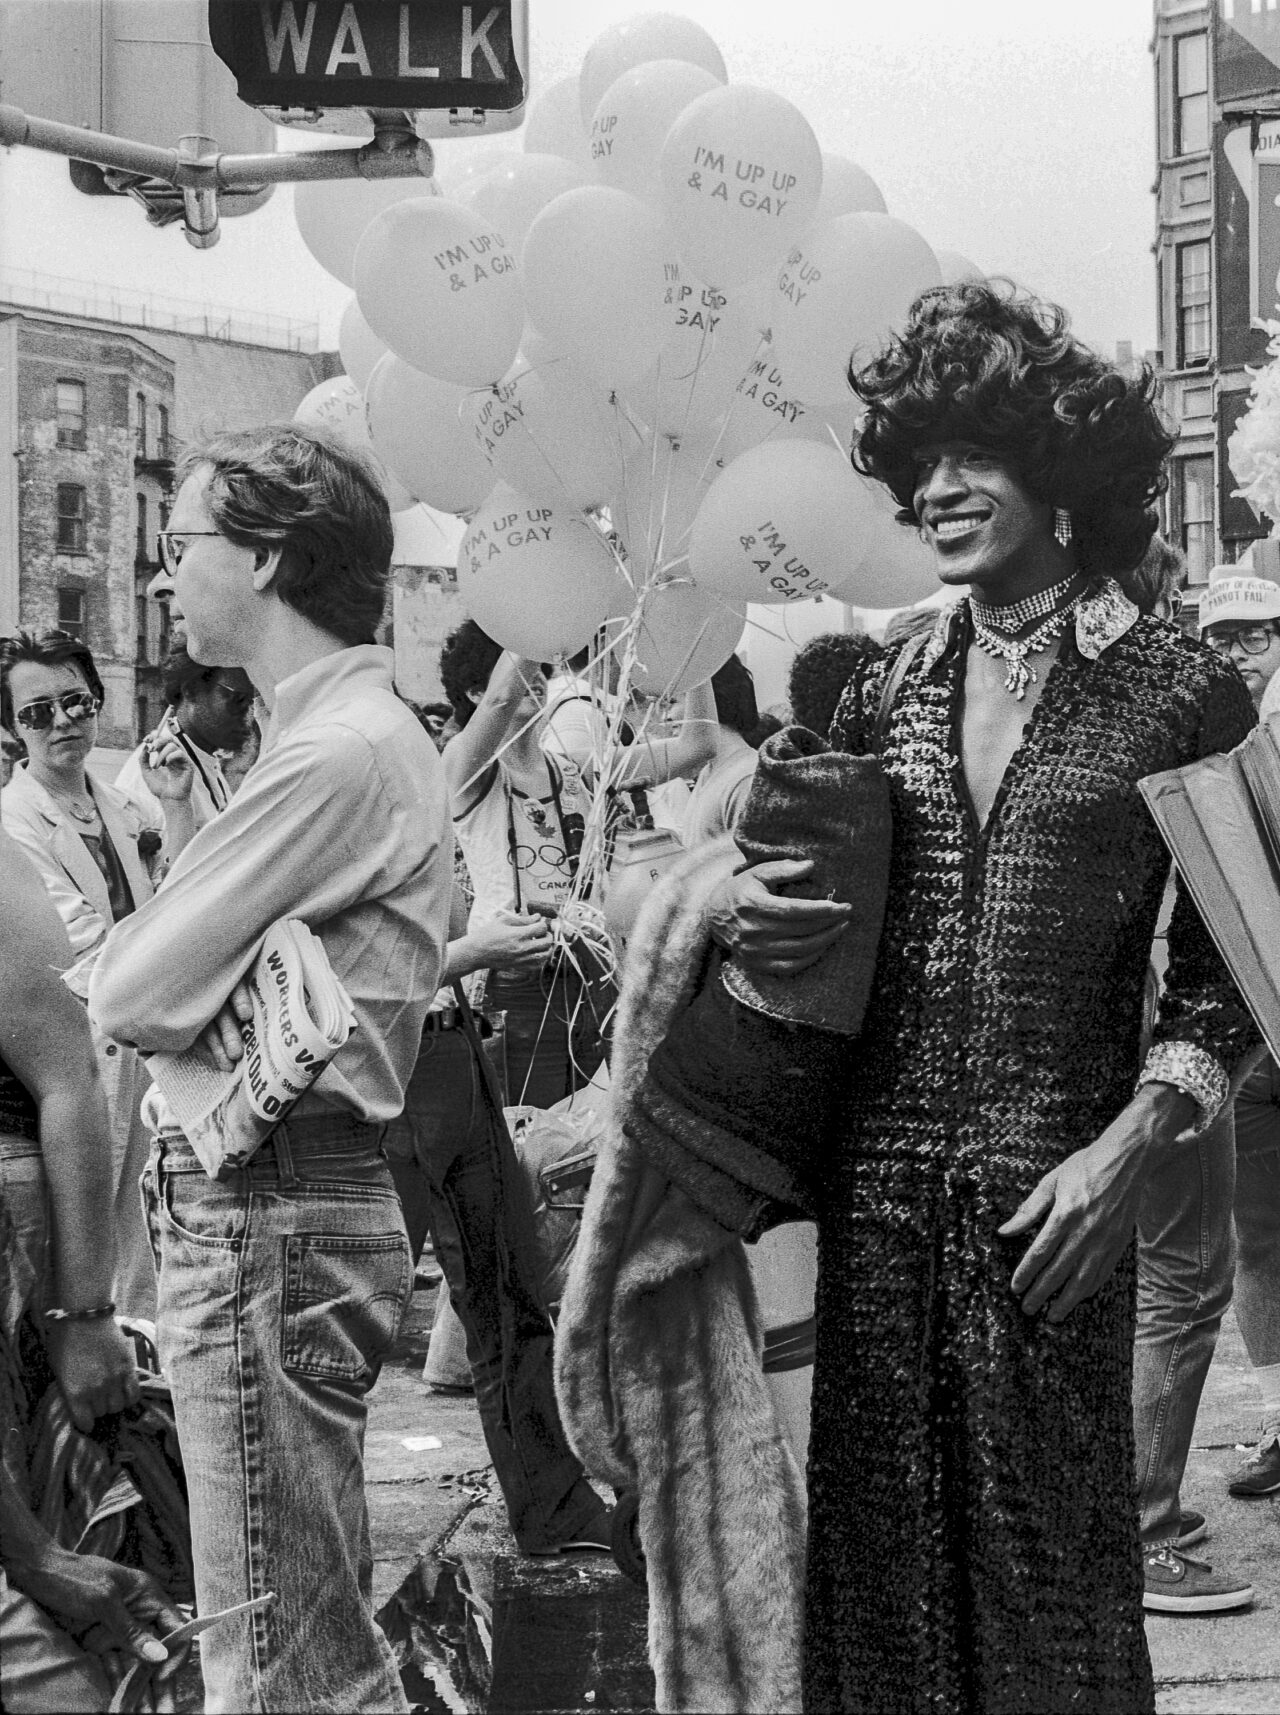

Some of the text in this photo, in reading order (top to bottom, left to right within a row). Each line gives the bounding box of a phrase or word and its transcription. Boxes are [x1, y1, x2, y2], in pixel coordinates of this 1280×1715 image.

[259, 1, 506, 80] WALK
[694, 146, 797, 193] I'M UP UP
[687, 171, 788, 217] & A GAY
[433, 244, 470, 271] I'M
[449, 272, 468, 293] &
[473, 263, 489, 283] A
[492, 399, 526, 438] GAY
[464, 508, 554, 556] I'M UP UP
[487, 541, 501, 561] A
[506, 526, 553, 548] GAY
[757, 520, 787, 557] I'M
[783, 556, 811, 579] UP
[751, 559, 772, 574] A
[266, 949, 328, 1077] WORKERS VA
[248, 1053, 269, 1103] Out
